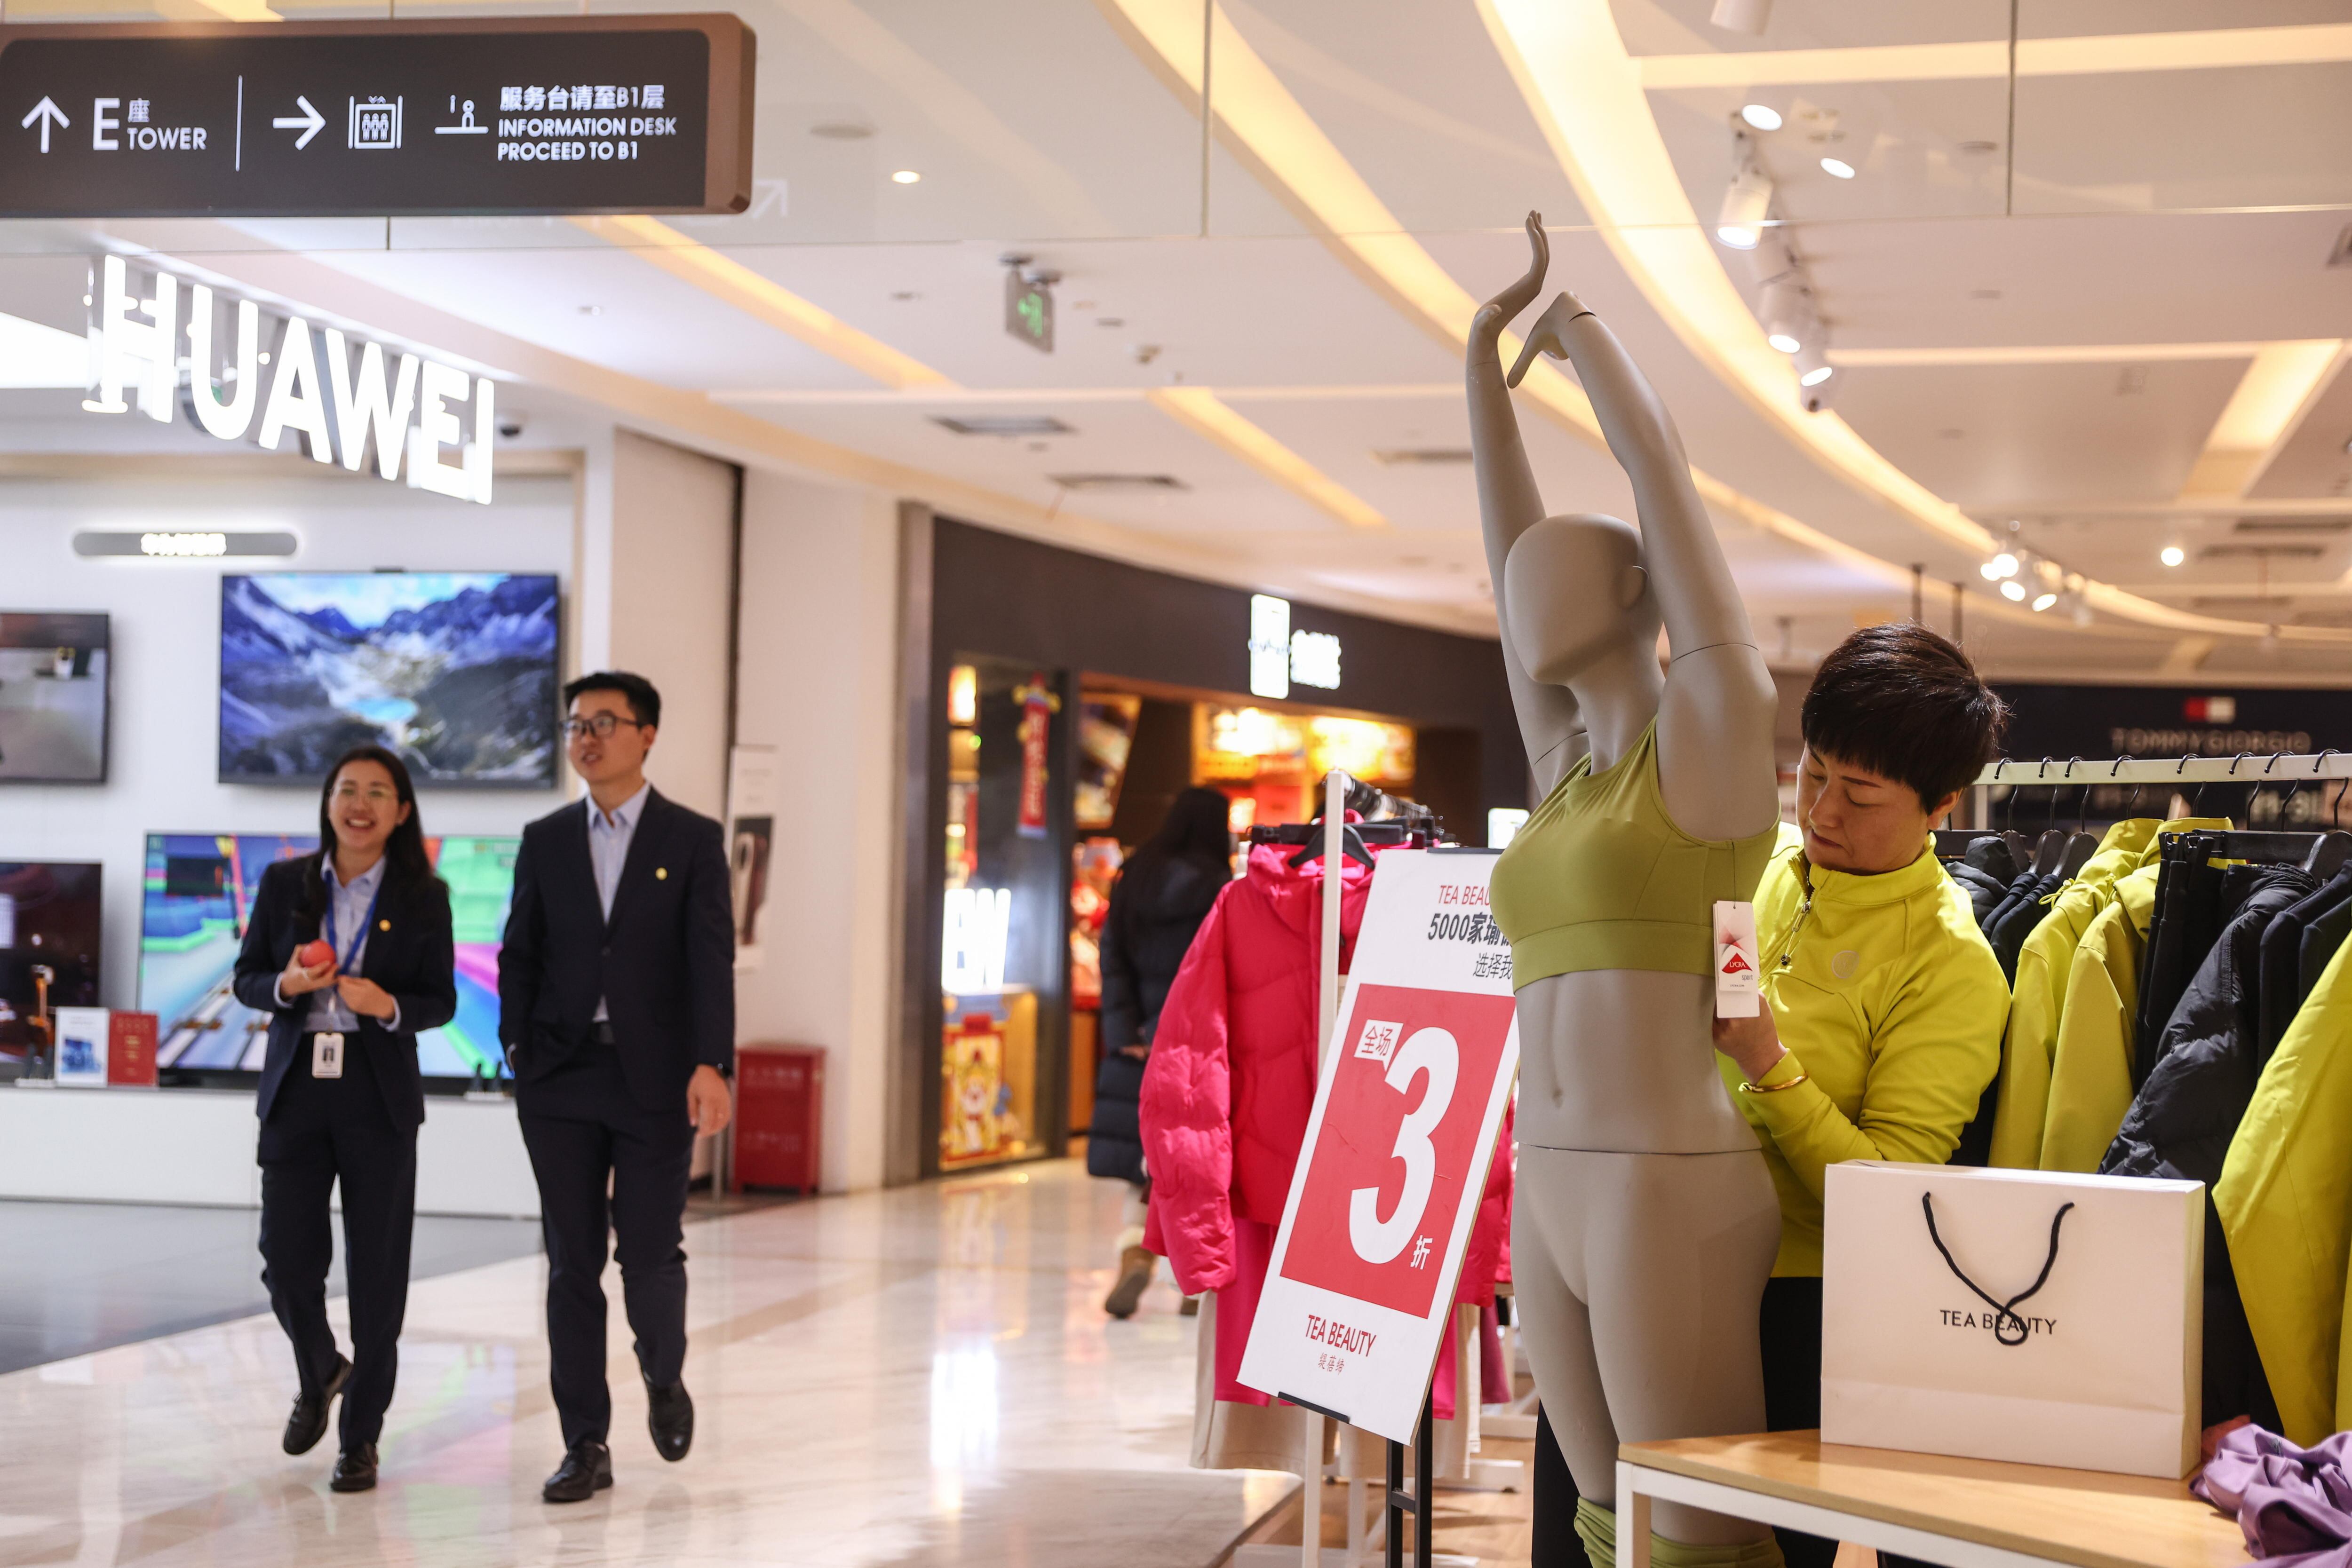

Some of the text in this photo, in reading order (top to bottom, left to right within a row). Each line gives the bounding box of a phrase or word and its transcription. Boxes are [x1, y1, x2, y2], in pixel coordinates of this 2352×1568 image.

[500, 85, 665, 111] 服务台请至B1层
[93, 98, 150, 150] E 座
[127, 127, 207, 150] TOWER
[498, 117, 677, 137] INFORMATION DESK
[497, 141, 638, 161] PROCEED TO B1
[101, 254, 495, 505] HUAWEI
[1438, 885, 1459, 904] TEA
[1428, 911, 1511, 946] 5000家瑜
[1361, 1024, 1393, 1056] 全场
[1349, 1026, 1459, 1264] 3
[1410, 1235, 1433, 1270] 折
[1940, 1309, 1976, 1328] TEA
[1305, 1314, 1376, 1357] TEA BEAUTY
